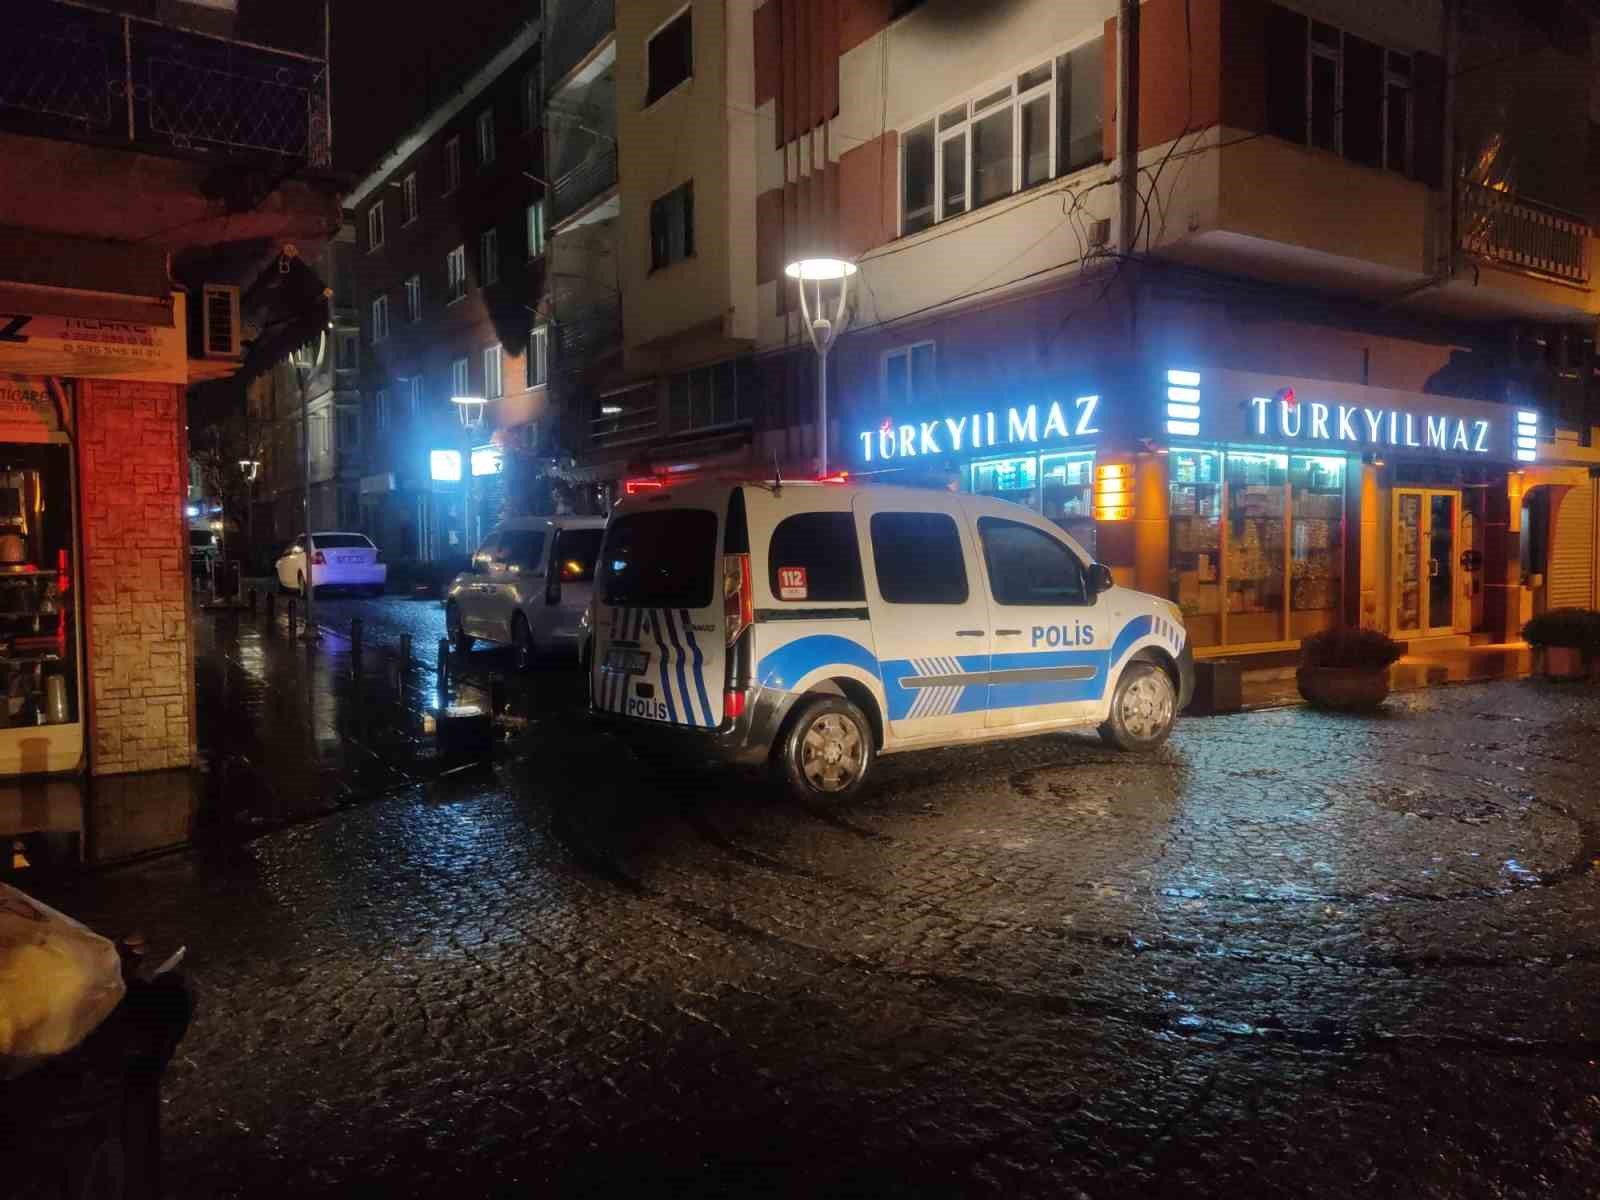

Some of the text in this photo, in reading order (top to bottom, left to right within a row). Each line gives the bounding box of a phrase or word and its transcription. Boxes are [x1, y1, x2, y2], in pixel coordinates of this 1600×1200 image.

[1252, 388, 1490, 453] TÜRKYILMAZ
[782, 570, 804, 587] 112
[1032, 619, 1095, 648] POLİS
[628, 697, 667, 720] POLİS
